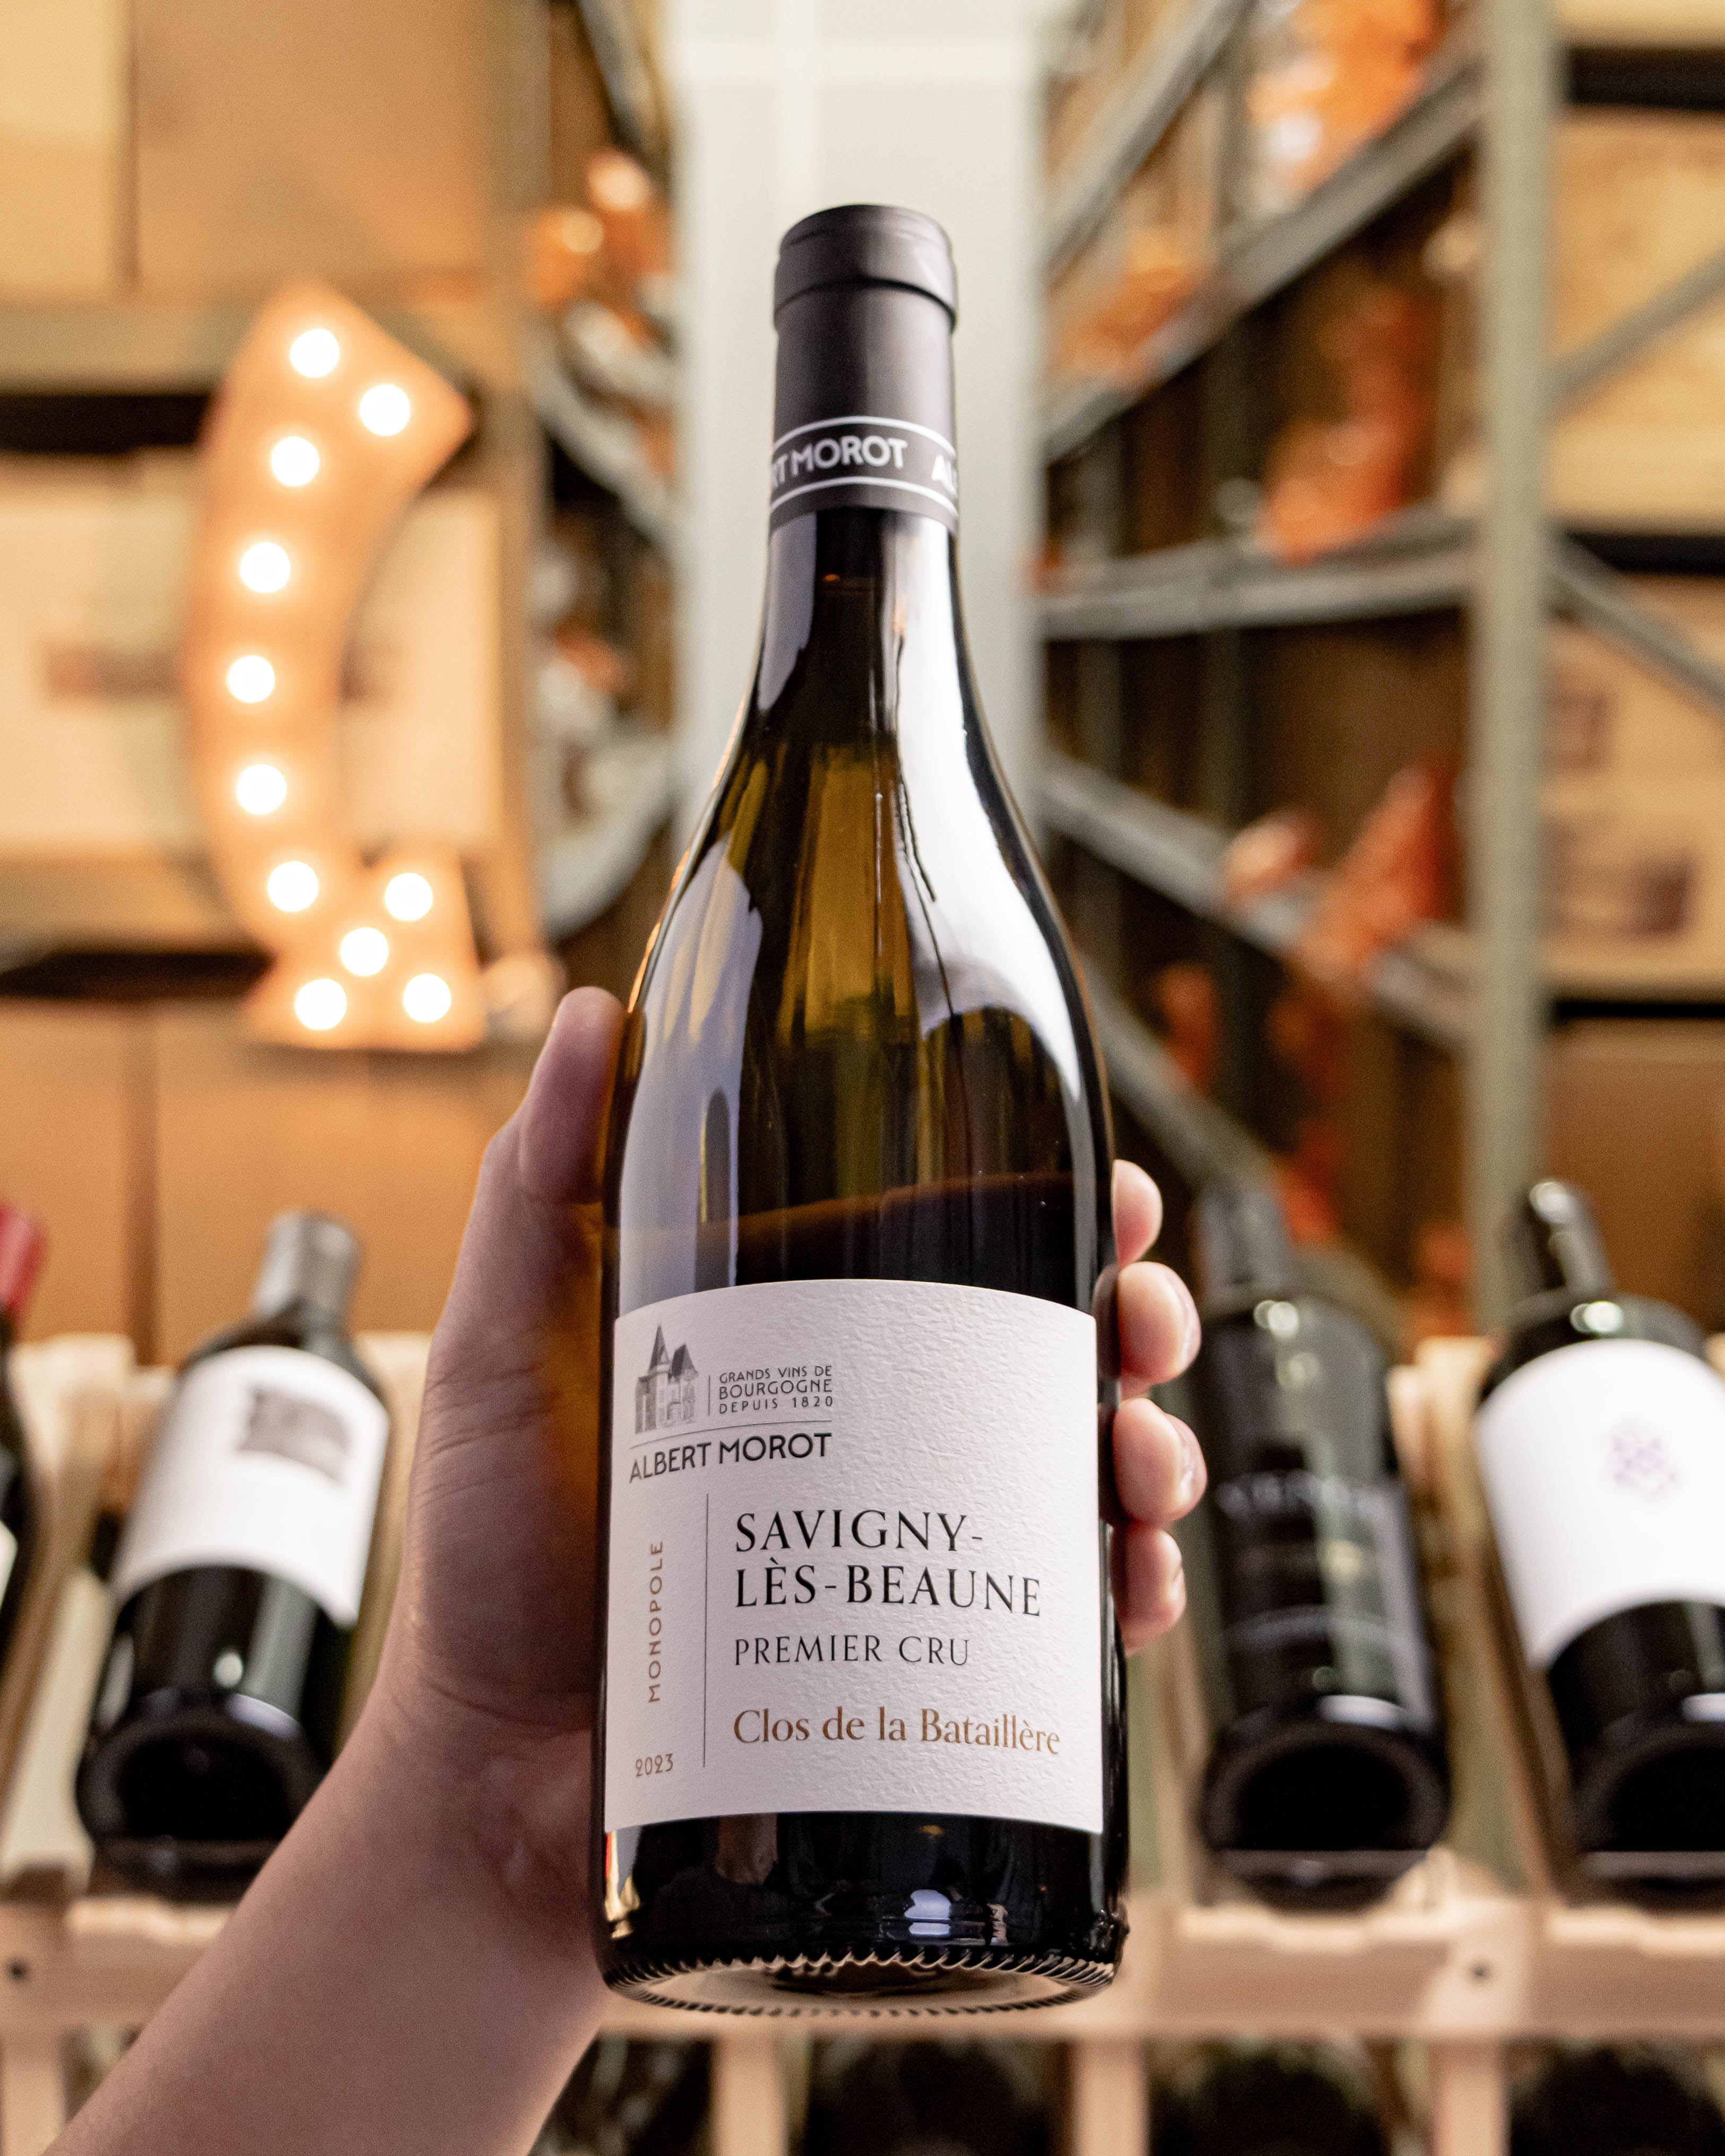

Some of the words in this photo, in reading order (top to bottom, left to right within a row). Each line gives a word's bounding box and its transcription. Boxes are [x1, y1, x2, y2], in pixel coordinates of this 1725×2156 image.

[790, 435, 908, 476] MOROT
[719, 1379, 833, 1400] BOURGOGNE
[720, 1368, 770, 1384] GRANDS
[778, 1366, 808, 1378] VINS
[814, 1366, 833, 1376] DE
[719, 1398, 778, 1414] DEPUIS
[792, 1396, 833, 1408] 1820
[629, 1441, 712, 1484] ALBERT
[719, 1432, 833, 1464] MOROT
[735, 1509, 983, 1552] SAVIGNY-
[735, 1557, 1041, 1616] LÈS-BEAUNE
[648, 1541, 663, 1703] MONOPOLE
[734, 1635, 883, 1666] PREMIER
[898, 1636, 970, 1666] CRU
[734, 1708, 810, 1743] Clos
[822, 1706, 865, 1741] de
[878, 1706, 907, 1742] la
[920, 1708, 1061, 1755] Bataillère
[635, 1753, 674, 1777] 2023
